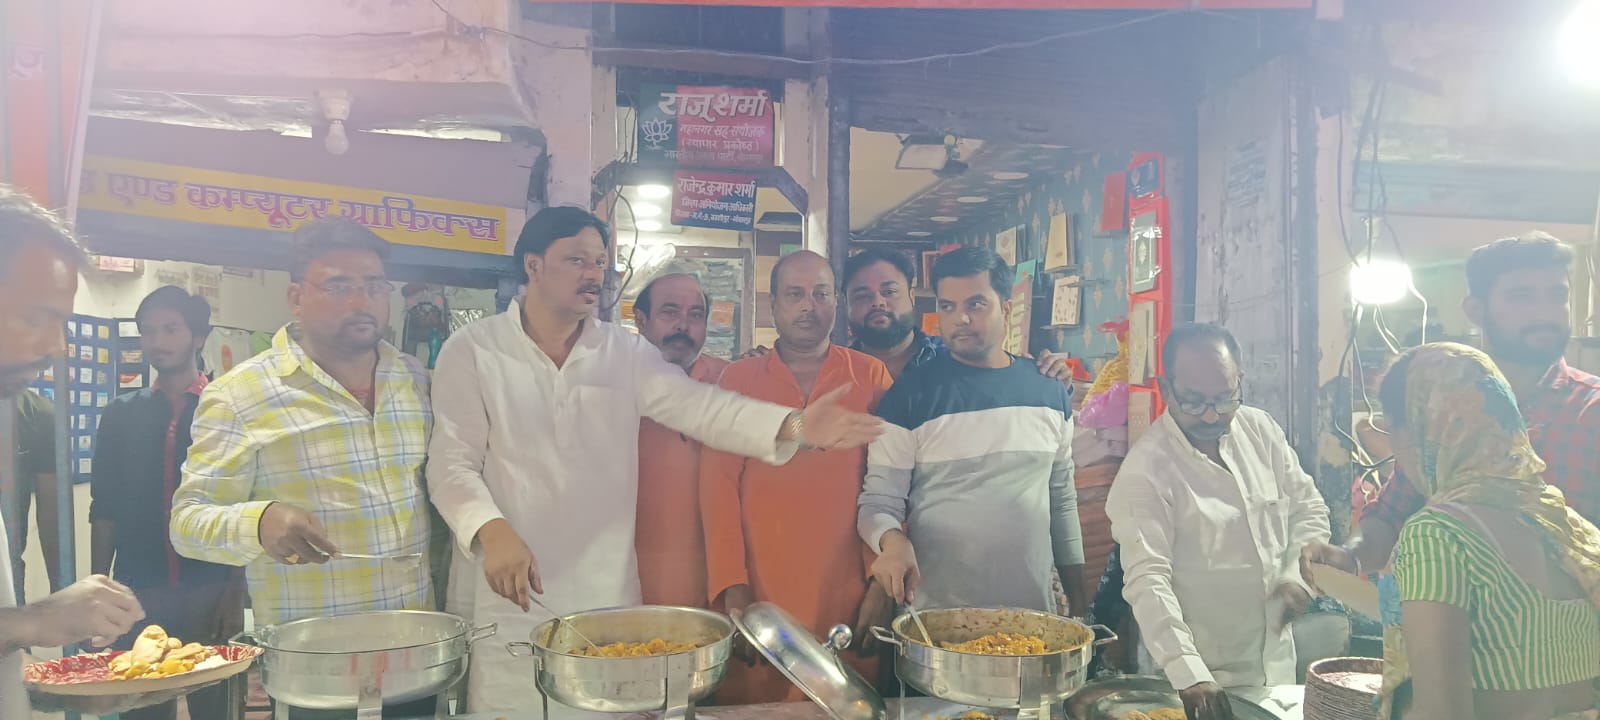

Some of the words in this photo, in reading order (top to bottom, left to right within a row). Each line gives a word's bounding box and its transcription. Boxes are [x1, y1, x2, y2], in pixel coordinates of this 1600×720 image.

[658, 92, 714, 122] राजू
[713, 89, 768, 117] शर्मा
[677, 175, 706, 194] राजेन्द्र
[706, 181, 733, 197] कुमार
[734, 179, 756, 199] शर्मा
[107, 172, 178, 207] एण्ड
[185, 181, 333, 229] कम्प्यूटर
[338, 195, 500, 242] ग्राफिक्स
